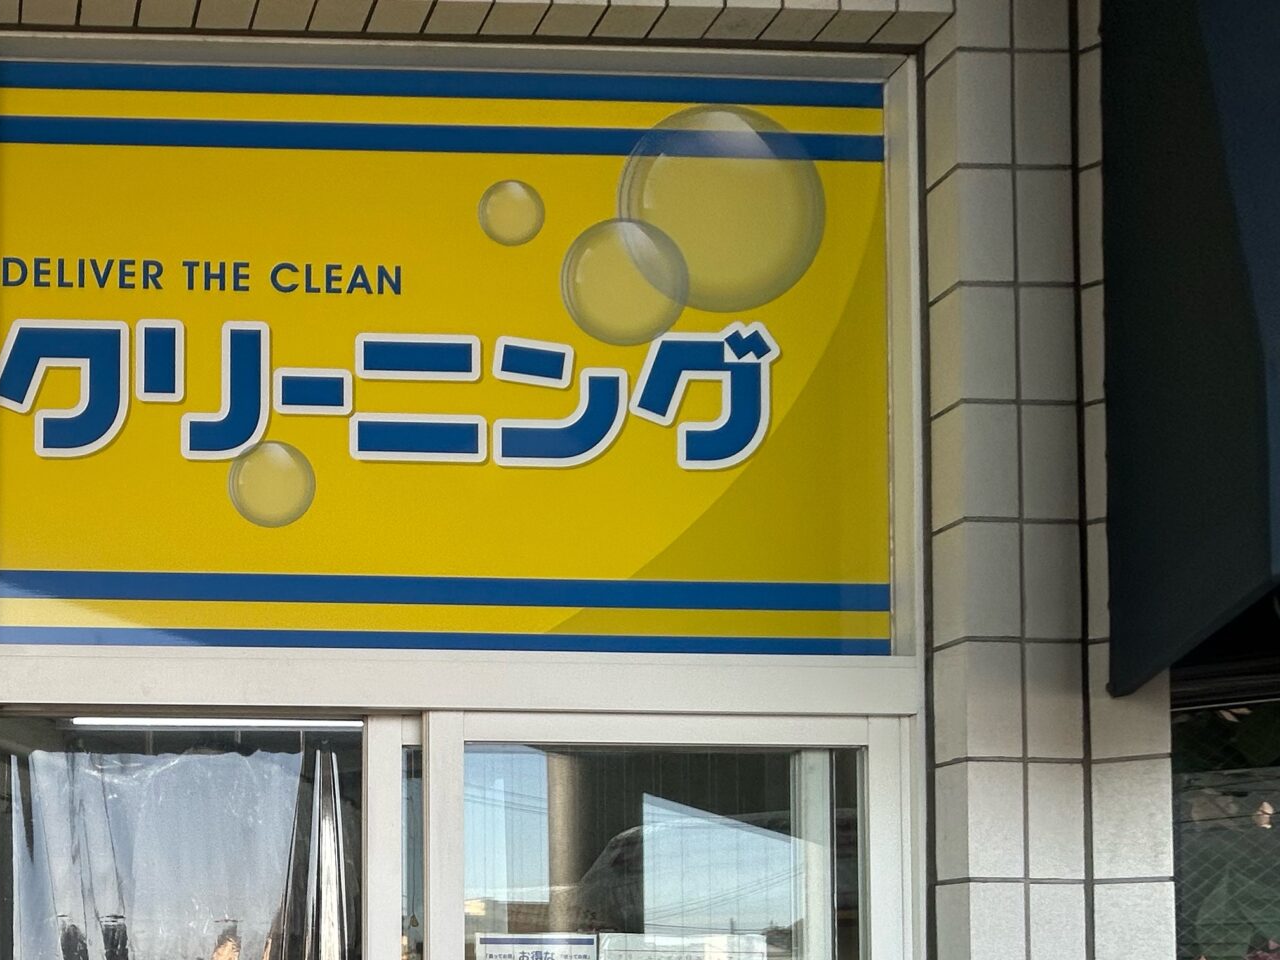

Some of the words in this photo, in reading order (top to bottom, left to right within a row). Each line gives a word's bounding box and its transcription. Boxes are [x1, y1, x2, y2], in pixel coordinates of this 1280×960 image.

[1, 256, 165, 291] DELIVER
[182, 260, 251, 293] THE
[269, 261, 403, 296] CLEAN
